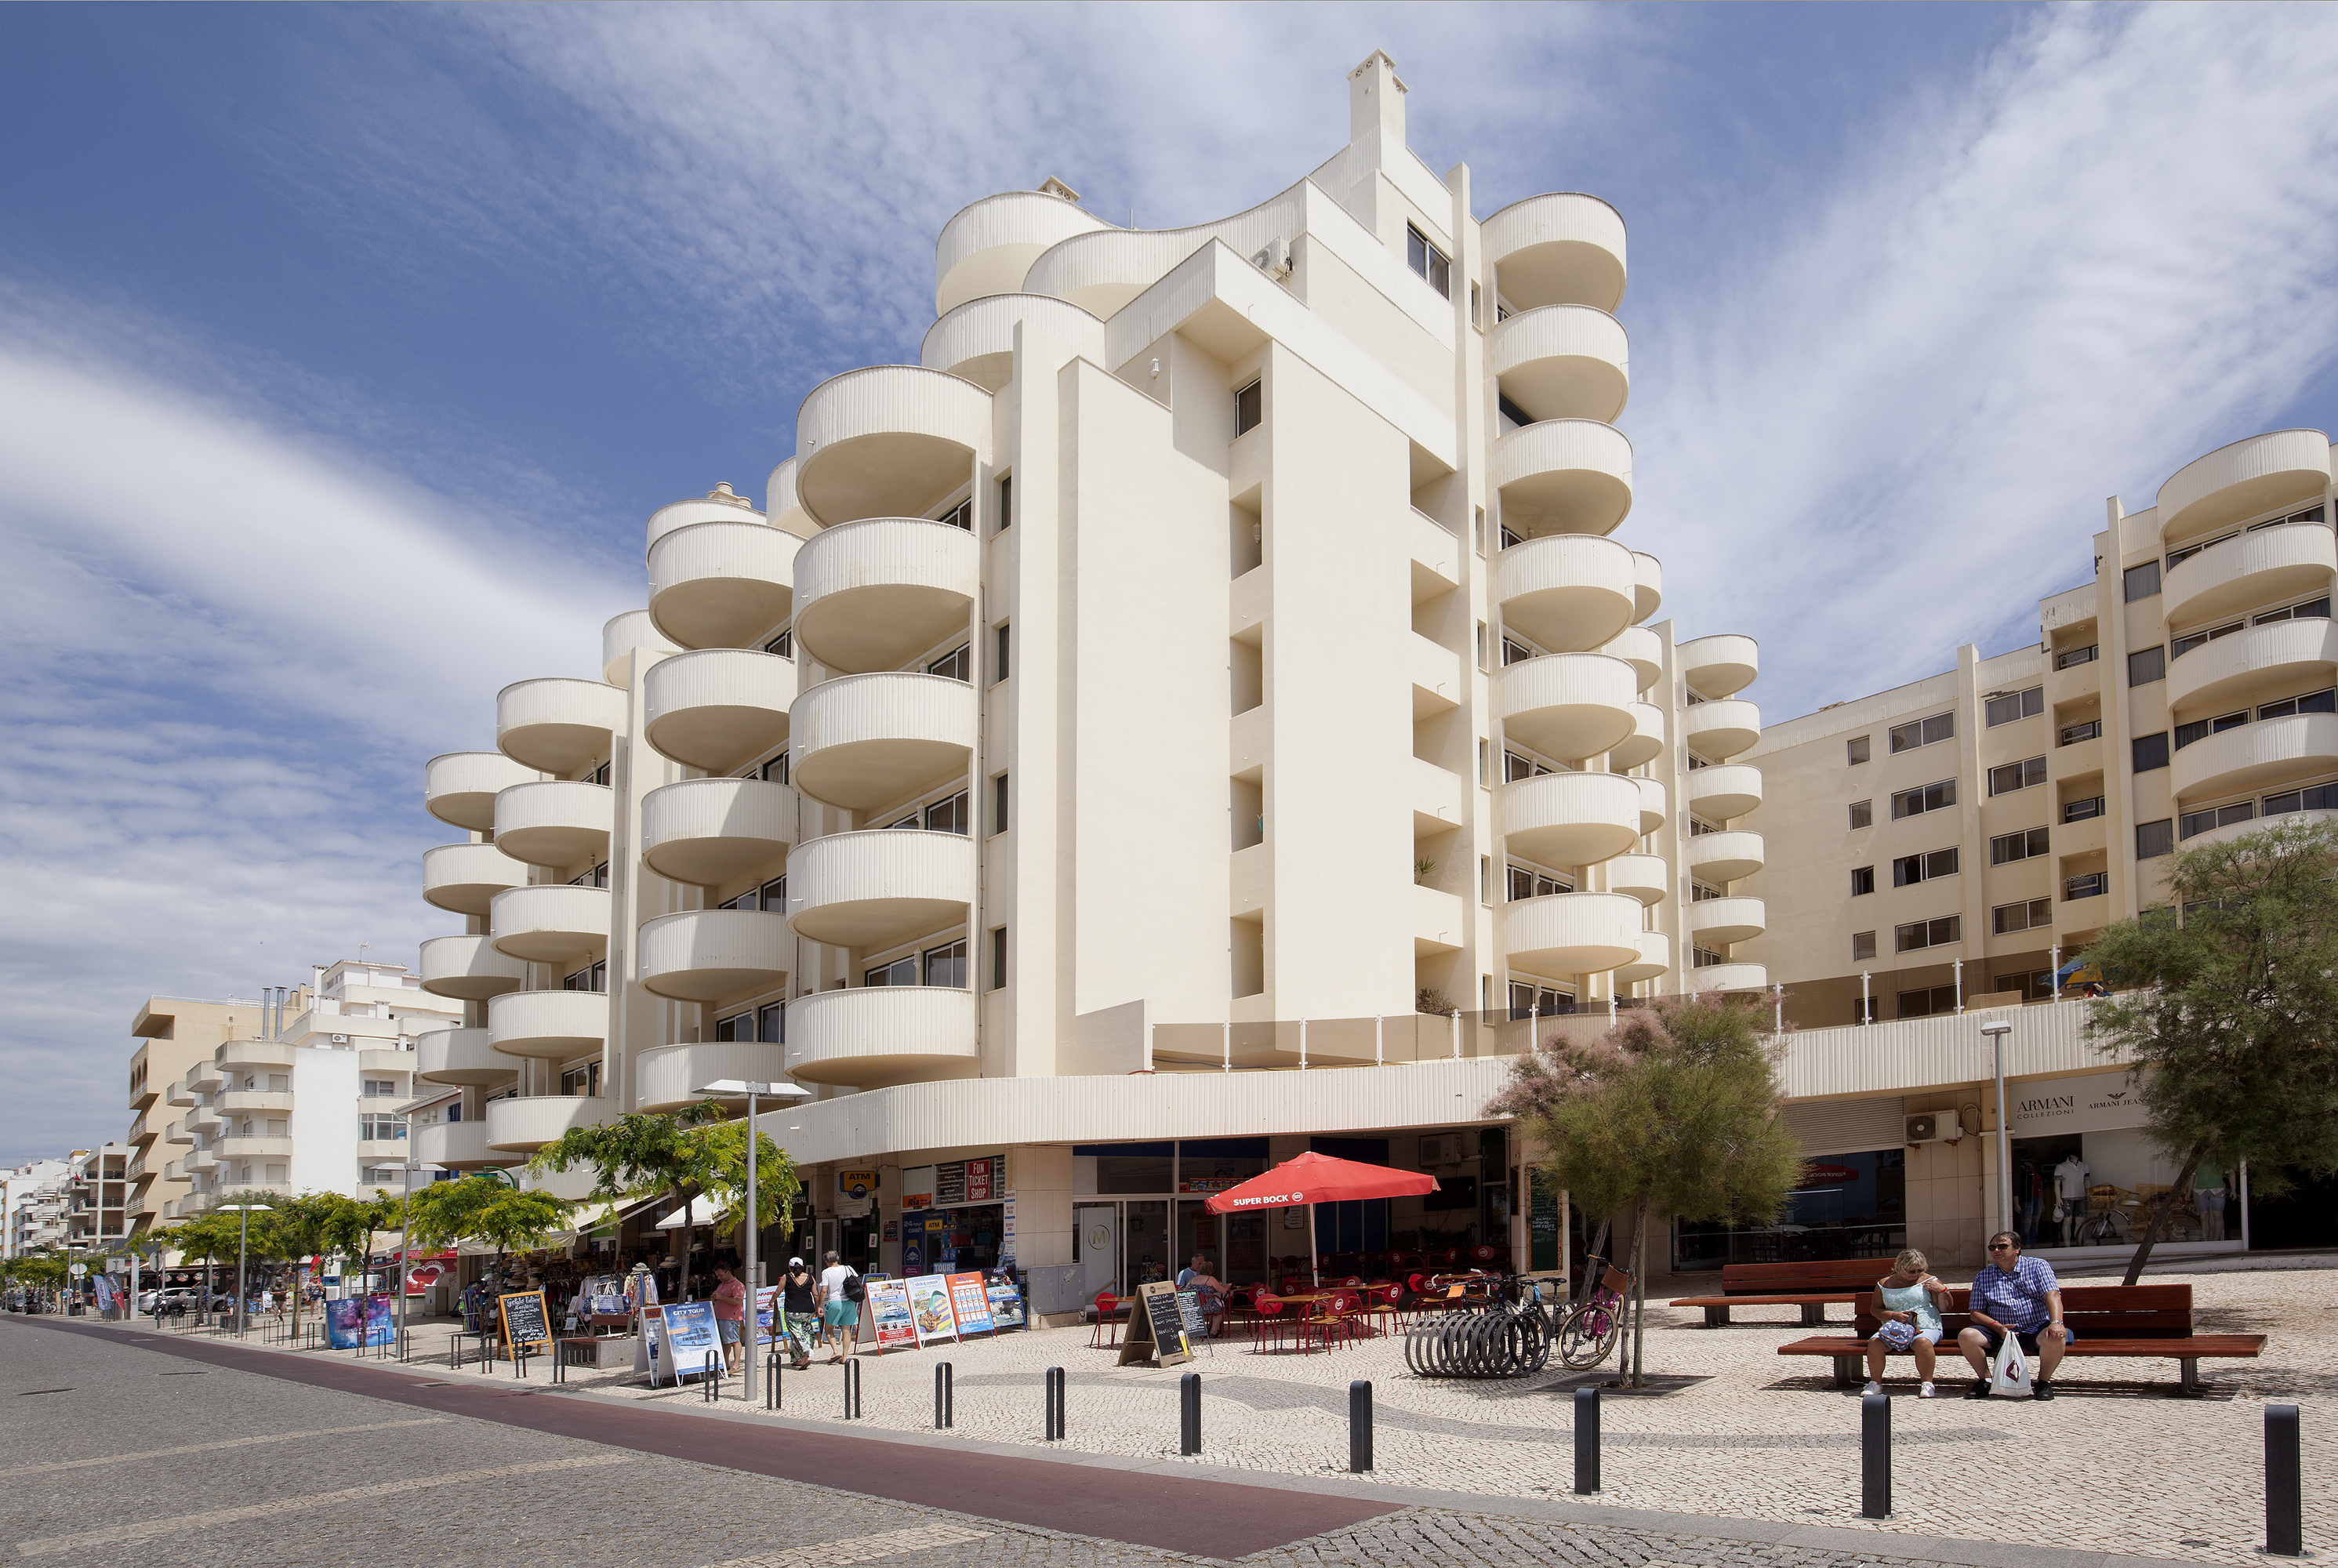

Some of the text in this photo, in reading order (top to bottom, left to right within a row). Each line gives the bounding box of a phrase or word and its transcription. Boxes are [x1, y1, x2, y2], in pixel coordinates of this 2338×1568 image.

[2017, 1095, 2074, 1112] ARMANI
[2088, 1100, 2120, 1109] ARMANI
[2017, 1109, 2074, 1120] COLLEZIONI
[973, 1163, 985, 1174] FUN
[968, 1174, 988, 1186] TICKET
[971, 1188, 986, 1200] SHOP
[908, 1196, 919, 1206] Ria
[1233, 1196, 1262, 1207] SUPER
[1263, 1194, 1289, 1204] BOCK
[1092, 1230, 1106, 1244] M
[934, 1263, 955, 1272] TOURS
